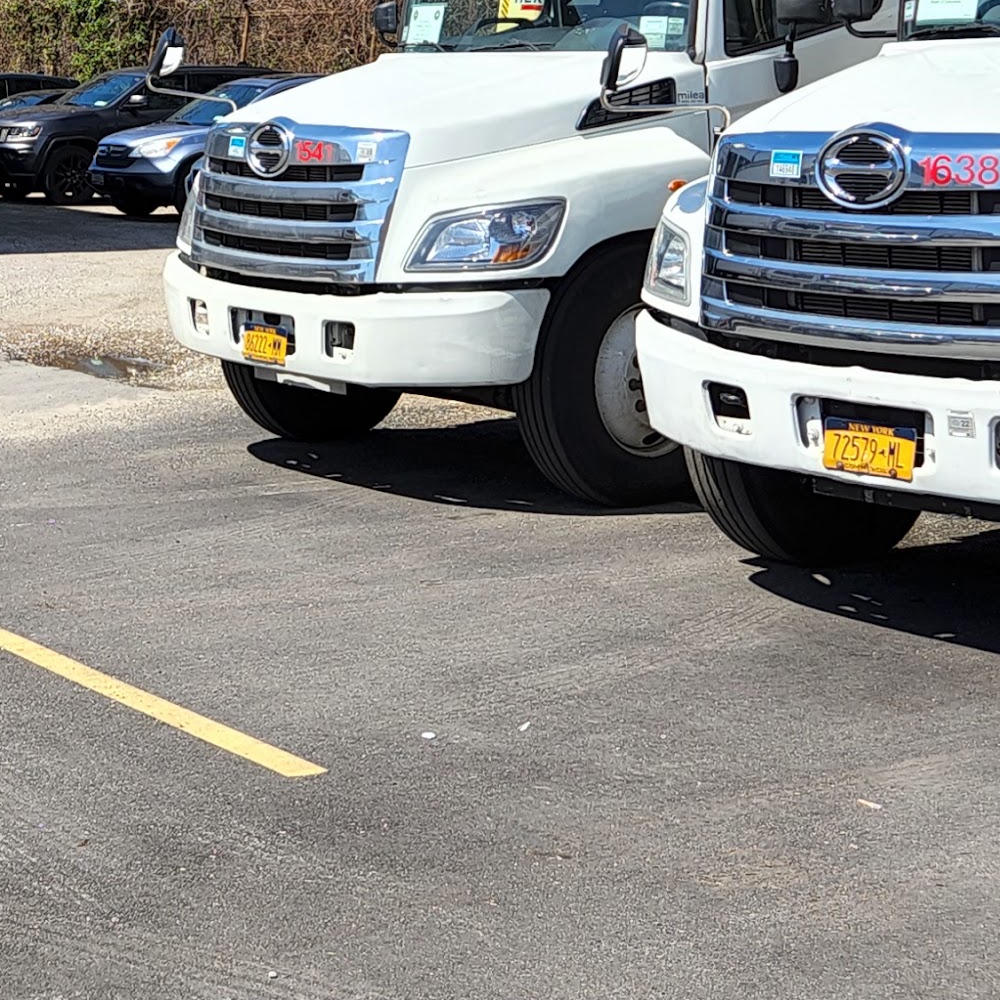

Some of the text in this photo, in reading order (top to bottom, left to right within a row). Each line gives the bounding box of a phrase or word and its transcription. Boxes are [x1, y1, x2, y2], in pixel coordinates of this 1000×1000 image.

[677, 90, 705, 100] milea
[295, 140, 332, 163] 1541
[918, 153, 1000, 187] 1638
[848, 422, 895, 437] NEW YORK
